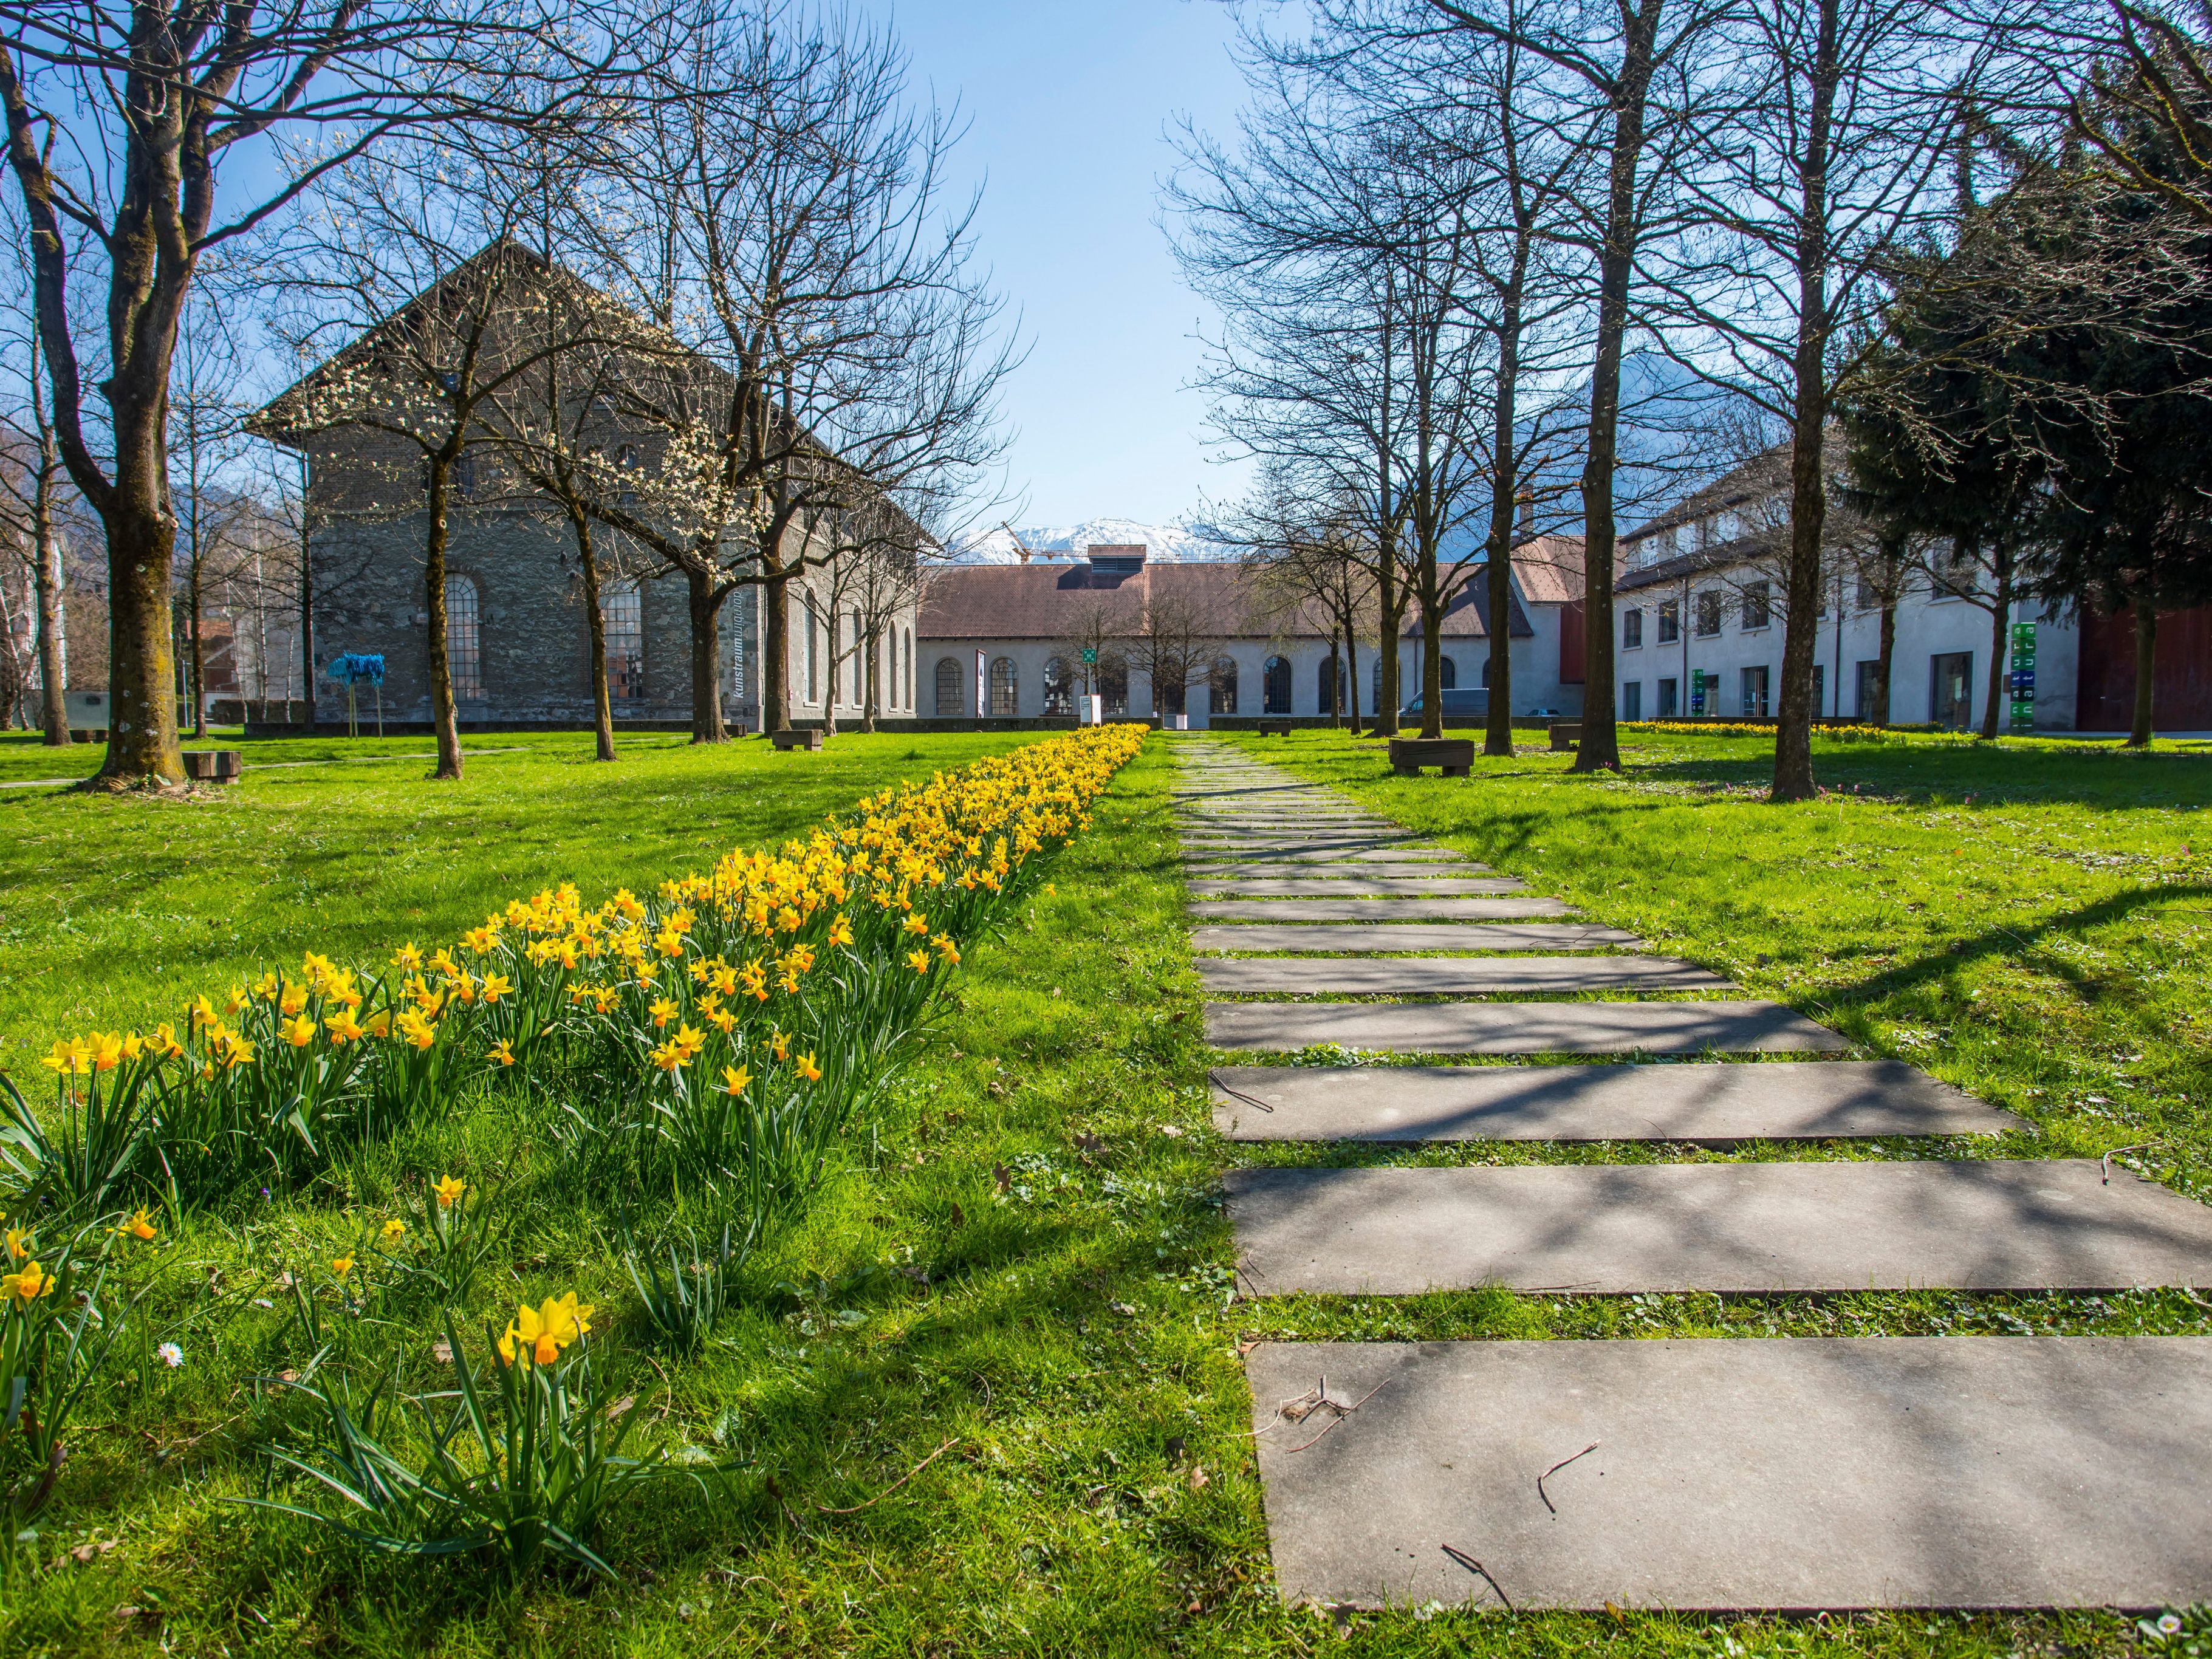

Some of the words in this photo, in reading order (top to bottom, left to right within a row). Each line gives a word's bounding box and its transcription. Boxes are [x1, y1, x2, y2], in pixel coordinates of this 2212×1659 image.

[733, 592, 744, 638] dornbirn
[733, 638, 744, 699] kunstraum
[2021, 626, 2035, 727] inatura
